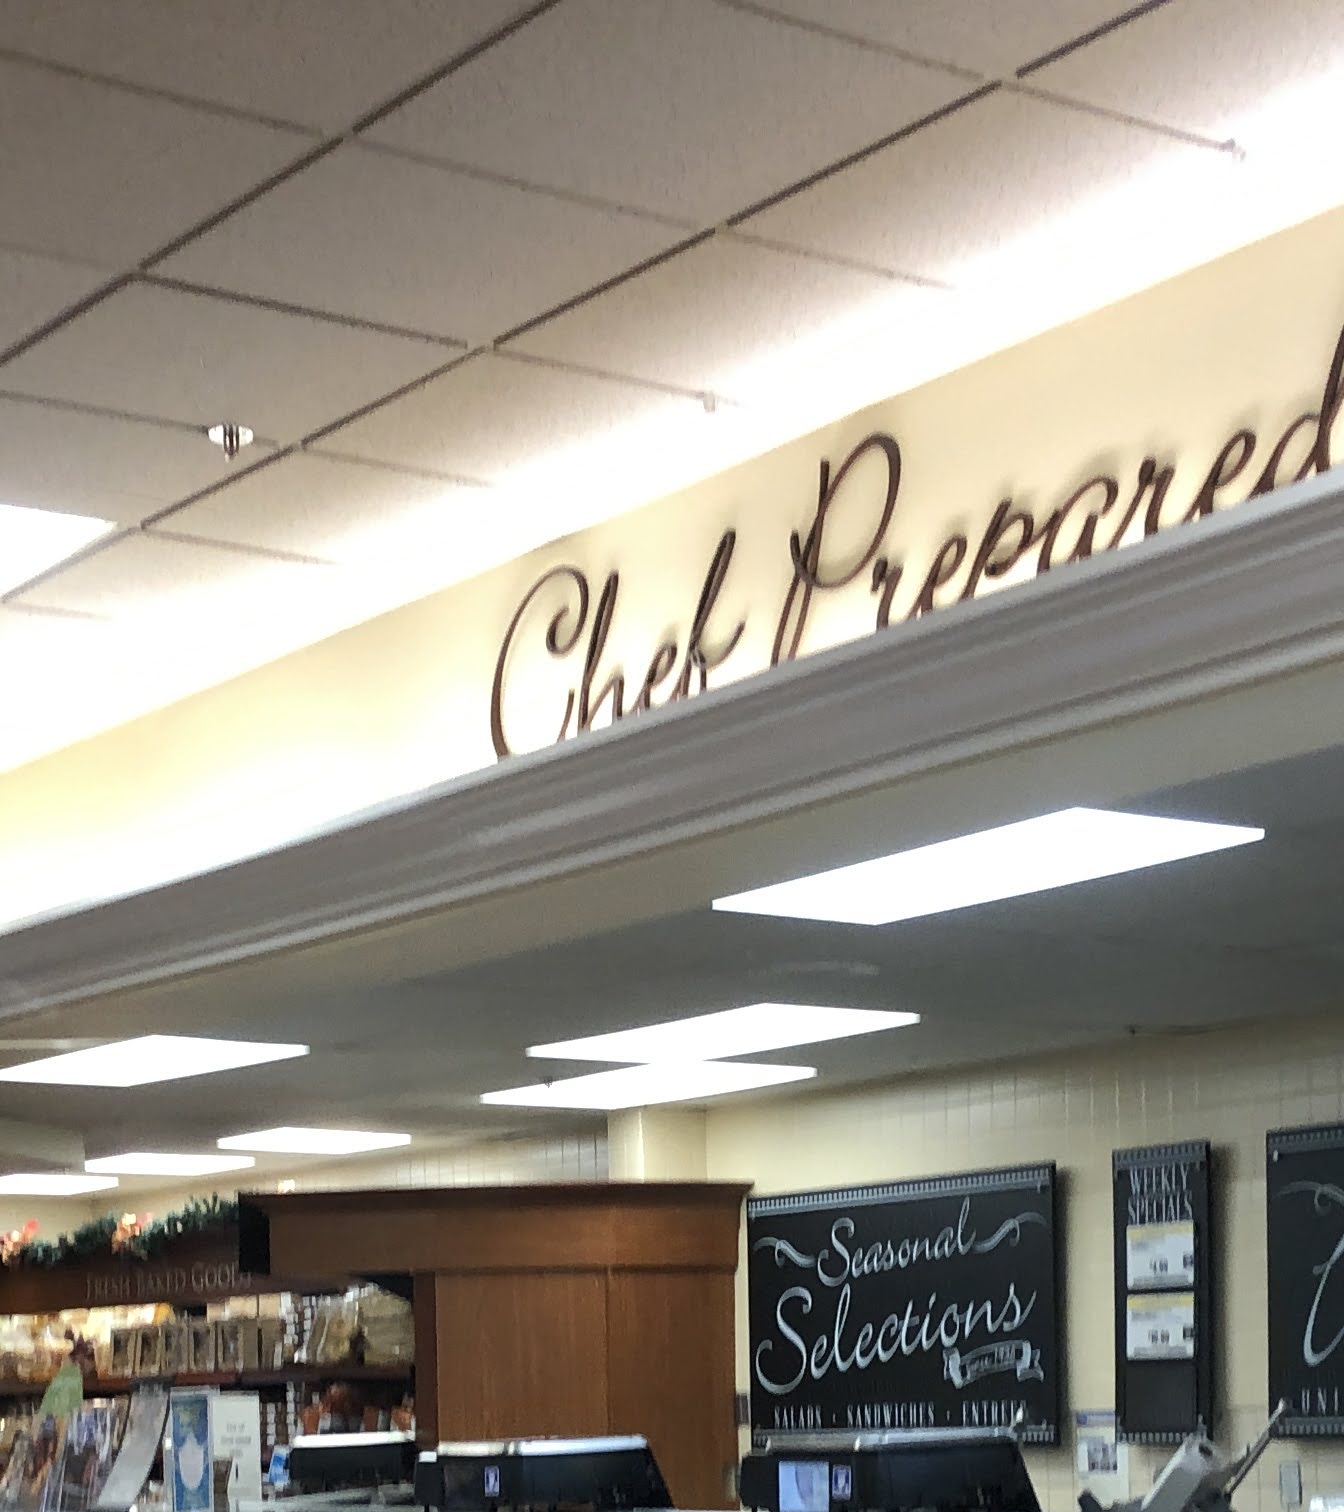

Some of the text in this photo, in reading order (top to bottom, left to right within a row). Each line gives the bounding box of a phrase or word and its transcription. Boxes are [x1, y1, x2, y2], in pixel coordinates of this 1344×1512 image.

[488, 527, 744, 762] Chef
[1127, 1192, 1193, 1226] SPECIALS
[1129, 1162, 1189, 1196] WEEKLY
[816, 1197, 979, 1287] Seasonal
[755, 1281, 1037, 1397] Selections
[774, 1403, 822, 1430] SALADS
[846, 1401, 936, 1428] SANDWICHES
